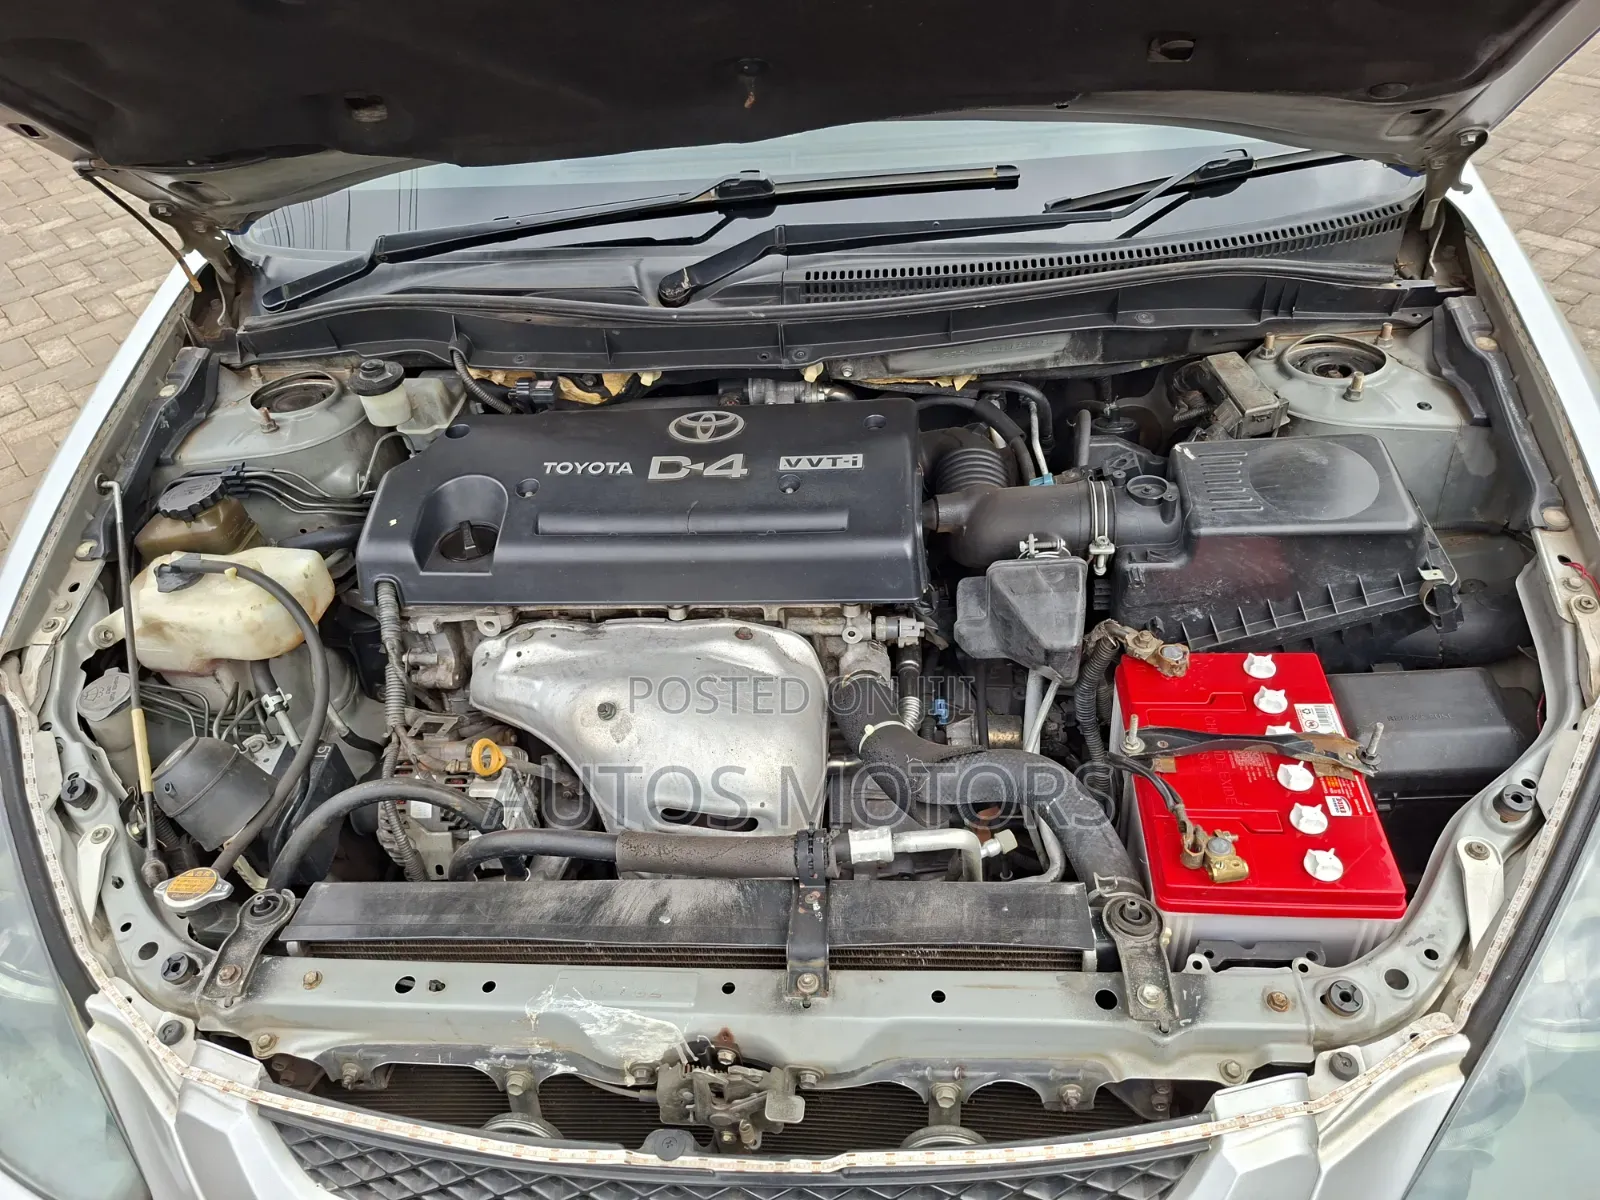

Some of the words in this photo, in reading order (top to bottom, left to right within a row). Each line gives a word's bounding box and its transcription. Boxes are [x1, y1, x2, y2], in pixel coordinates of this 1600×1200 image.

[543, 461, 634, 475] TOYOTA
[647, 453, 749, 481] D-4
[782, 455, 861, 469] VVT-i
